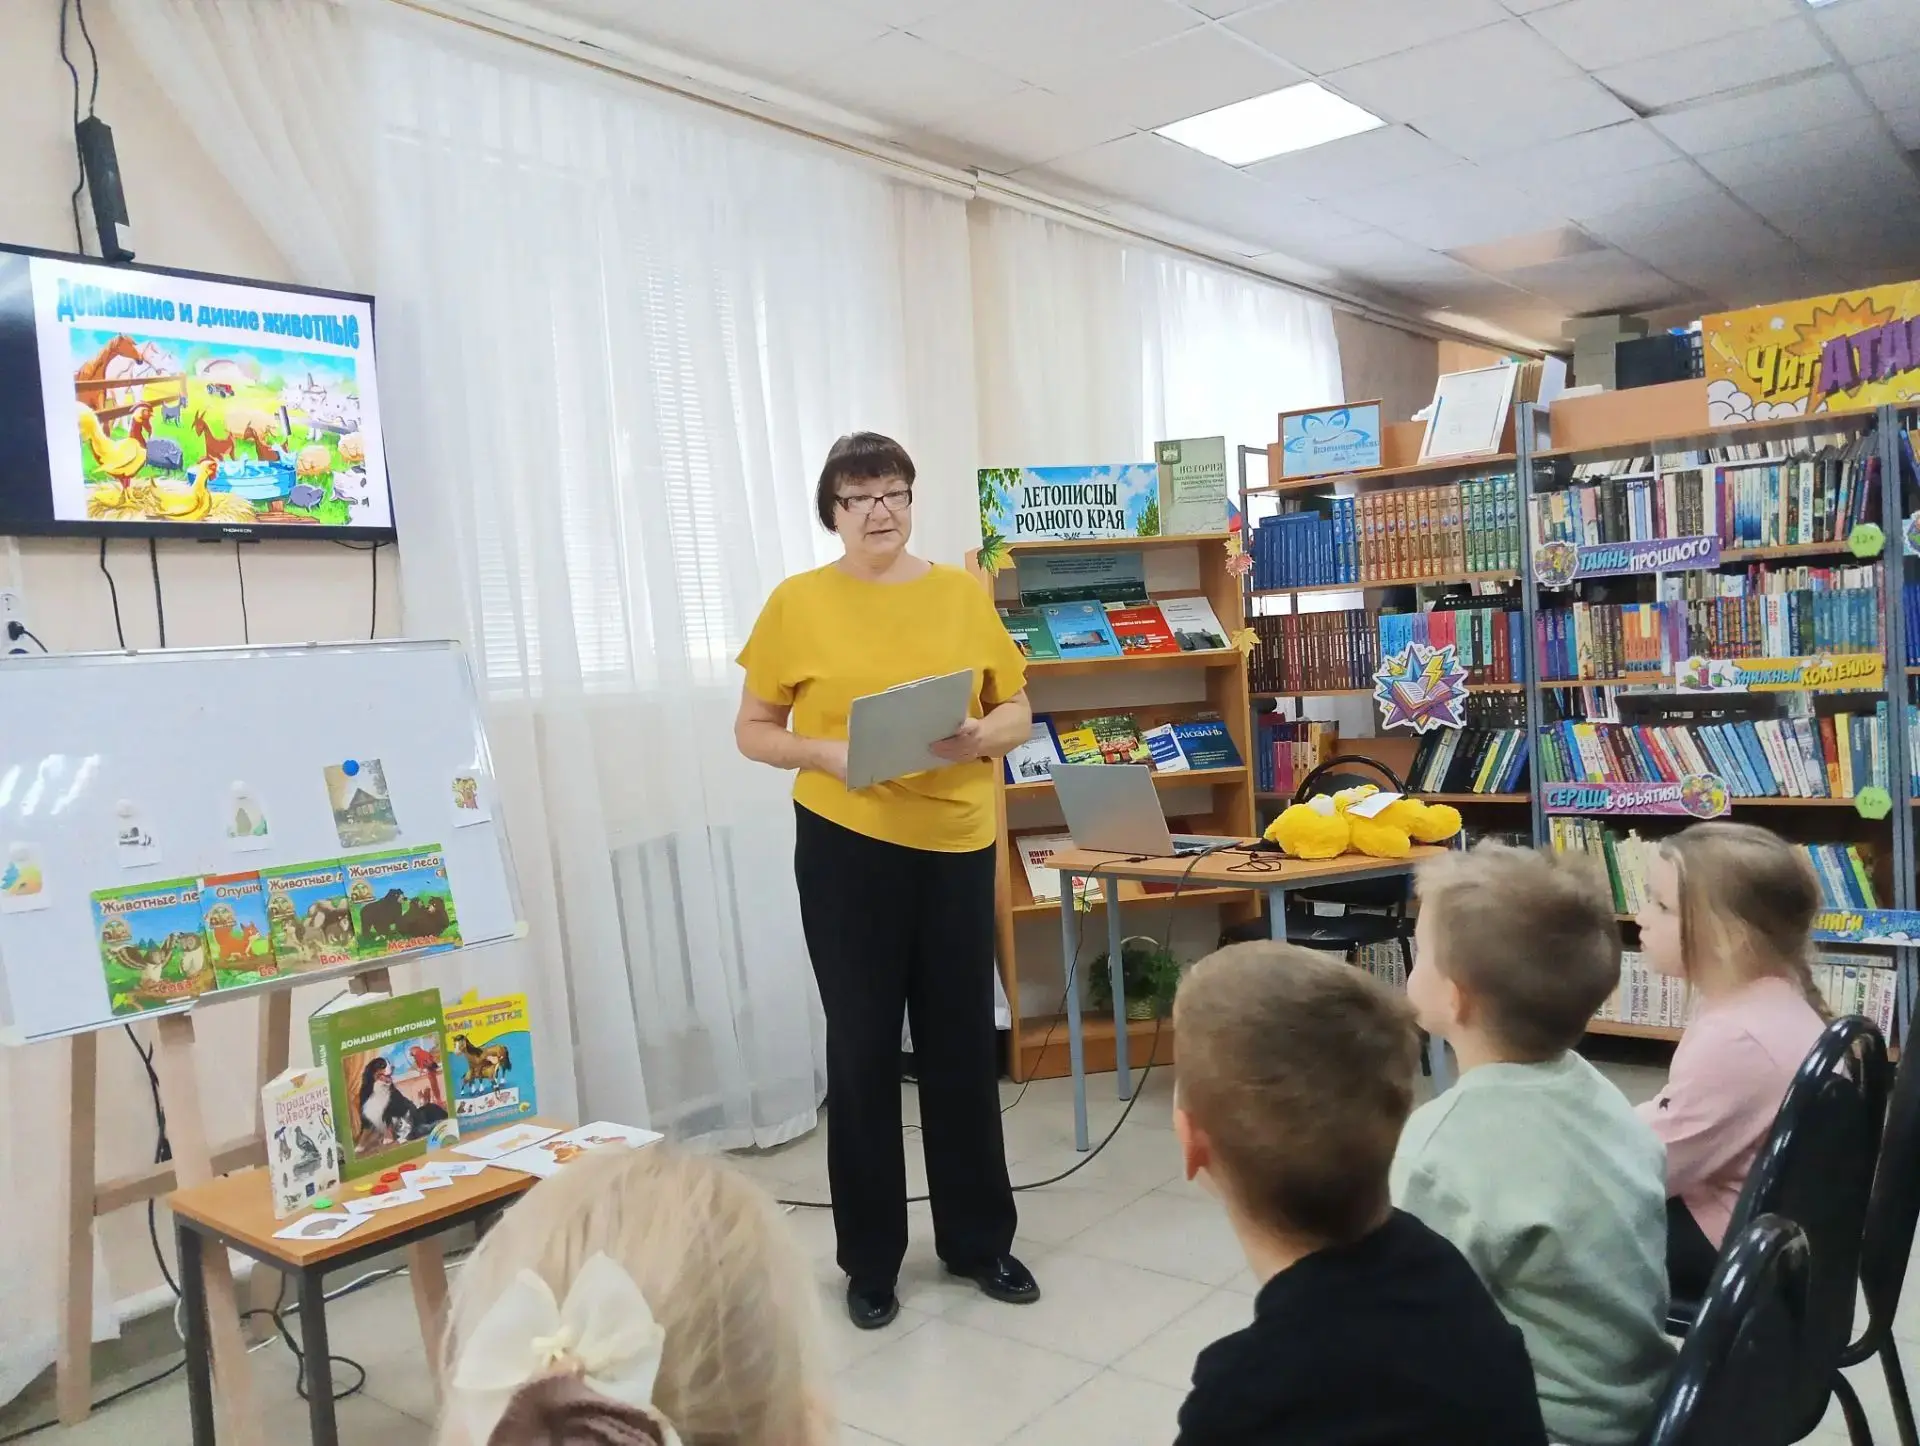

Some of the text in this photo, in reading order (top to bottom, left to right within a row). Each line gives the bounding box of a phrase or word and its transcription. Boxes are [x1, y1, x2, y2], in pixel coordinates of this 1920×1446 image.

[179, 302, 193, 323] и
[197, 305, 260, 331] дикие
[262, 311, 360, 350] животные
[1021, 483, 1118, 509] ЛЕТОПИСЦЫ
[1015, 508, 1126, 534] РОДНОГО КРАЯ
[1579, 537, 1711, 572] ТАЙНЫ ПРОШЛОГО
[1801, 658, 1876, 687] КОКТЕЙЛЬ
[1028, 849, 1055, 858] КНИГА
[350, 862, 409, 878] Животные
[413, 857, 440, 869] леса
[216, 884, 263, 899] Опушк
[269, 874, 332, 891] Животные
[102, 893, 177, 914] Животные
[340, 1017, 437, 1050] ДОМАШНИЕ ПИТОМЦЫ
[276, 1085, 329, 1117] Городские
